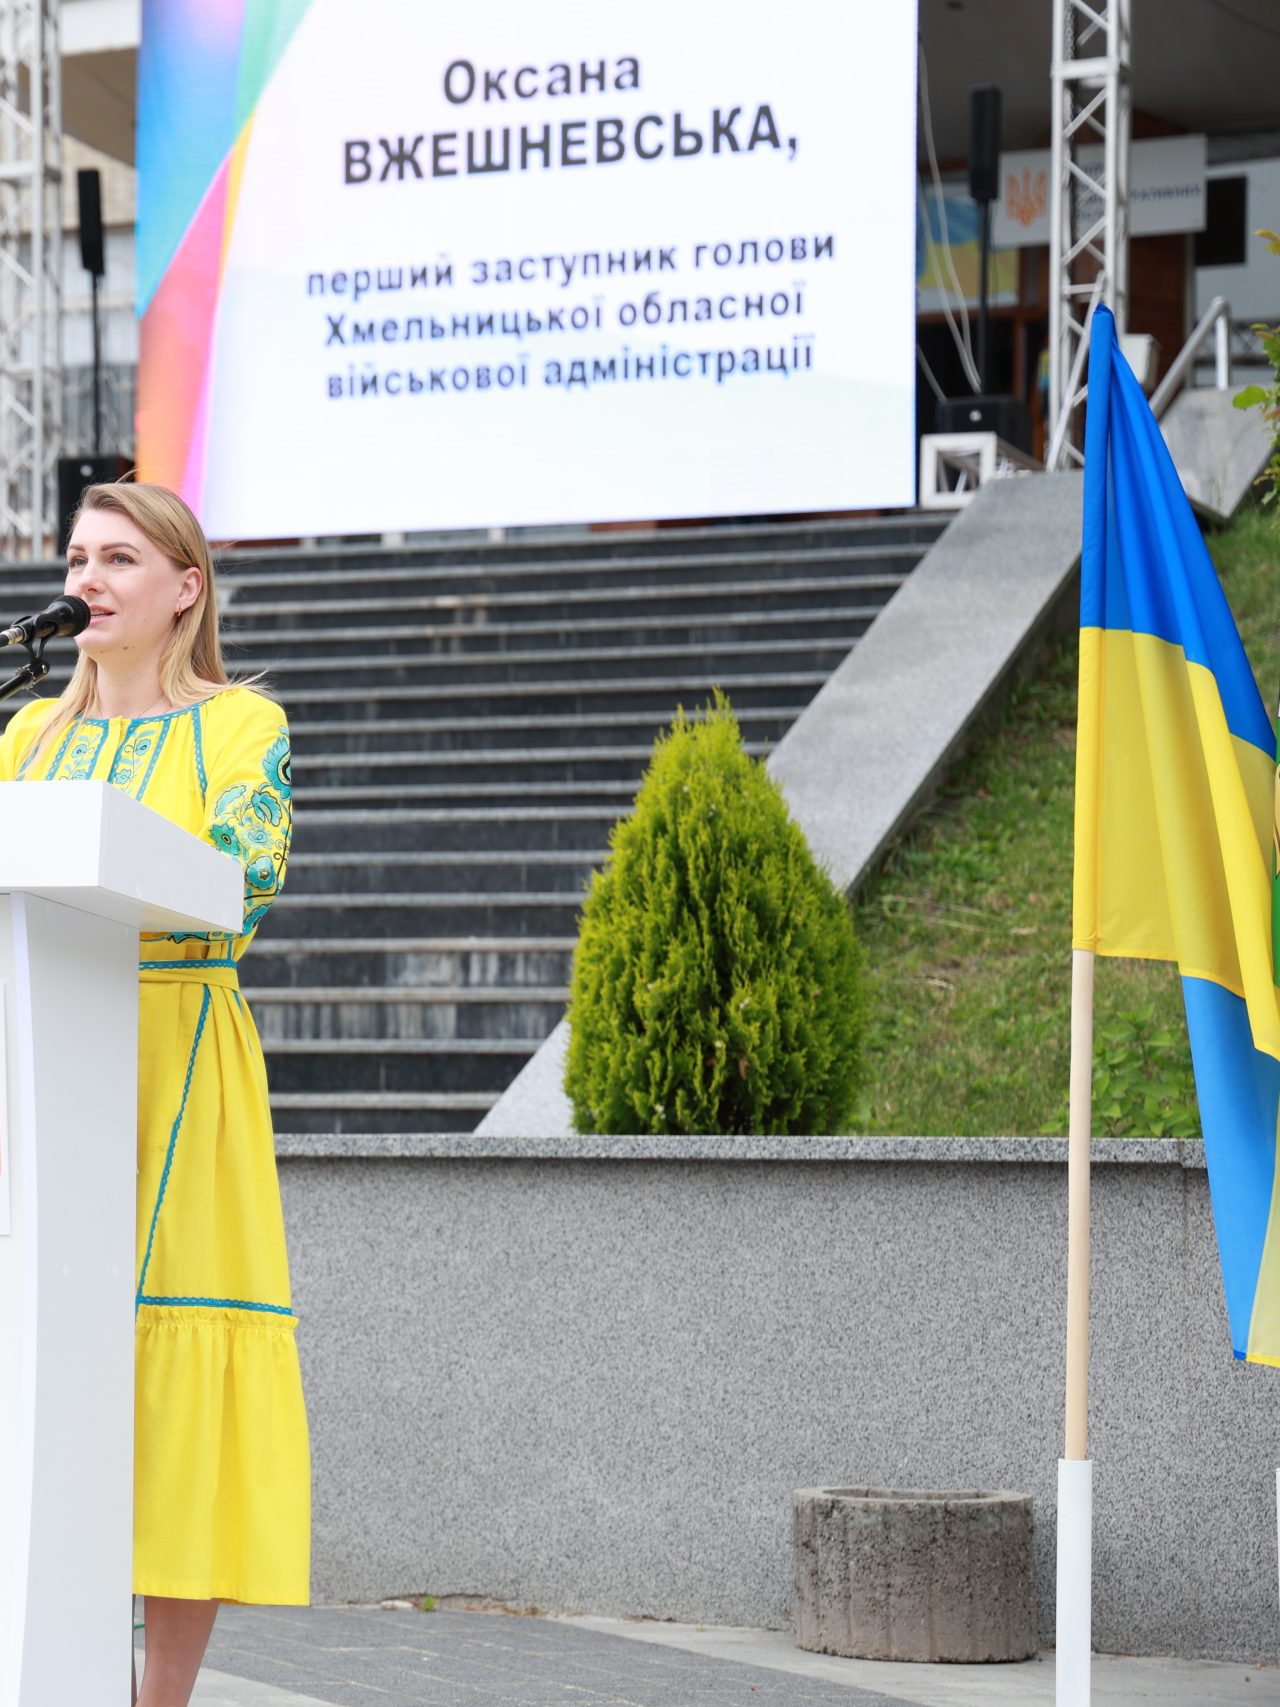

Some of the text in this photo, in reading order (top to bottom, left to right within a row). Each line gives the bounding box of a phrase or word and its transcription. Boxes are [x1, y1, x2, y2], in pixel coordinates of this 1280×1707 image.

[444, 56, 640, 104] Оксана
[344, 105, 798, 184] ВЖЕШНЕВСЬКА,
[308, 235, 834, 302] перший заступник голови
[327, 281, 806, 346] Хмельницької обласної
[328, 334, 815, 398] військової адміністрації
